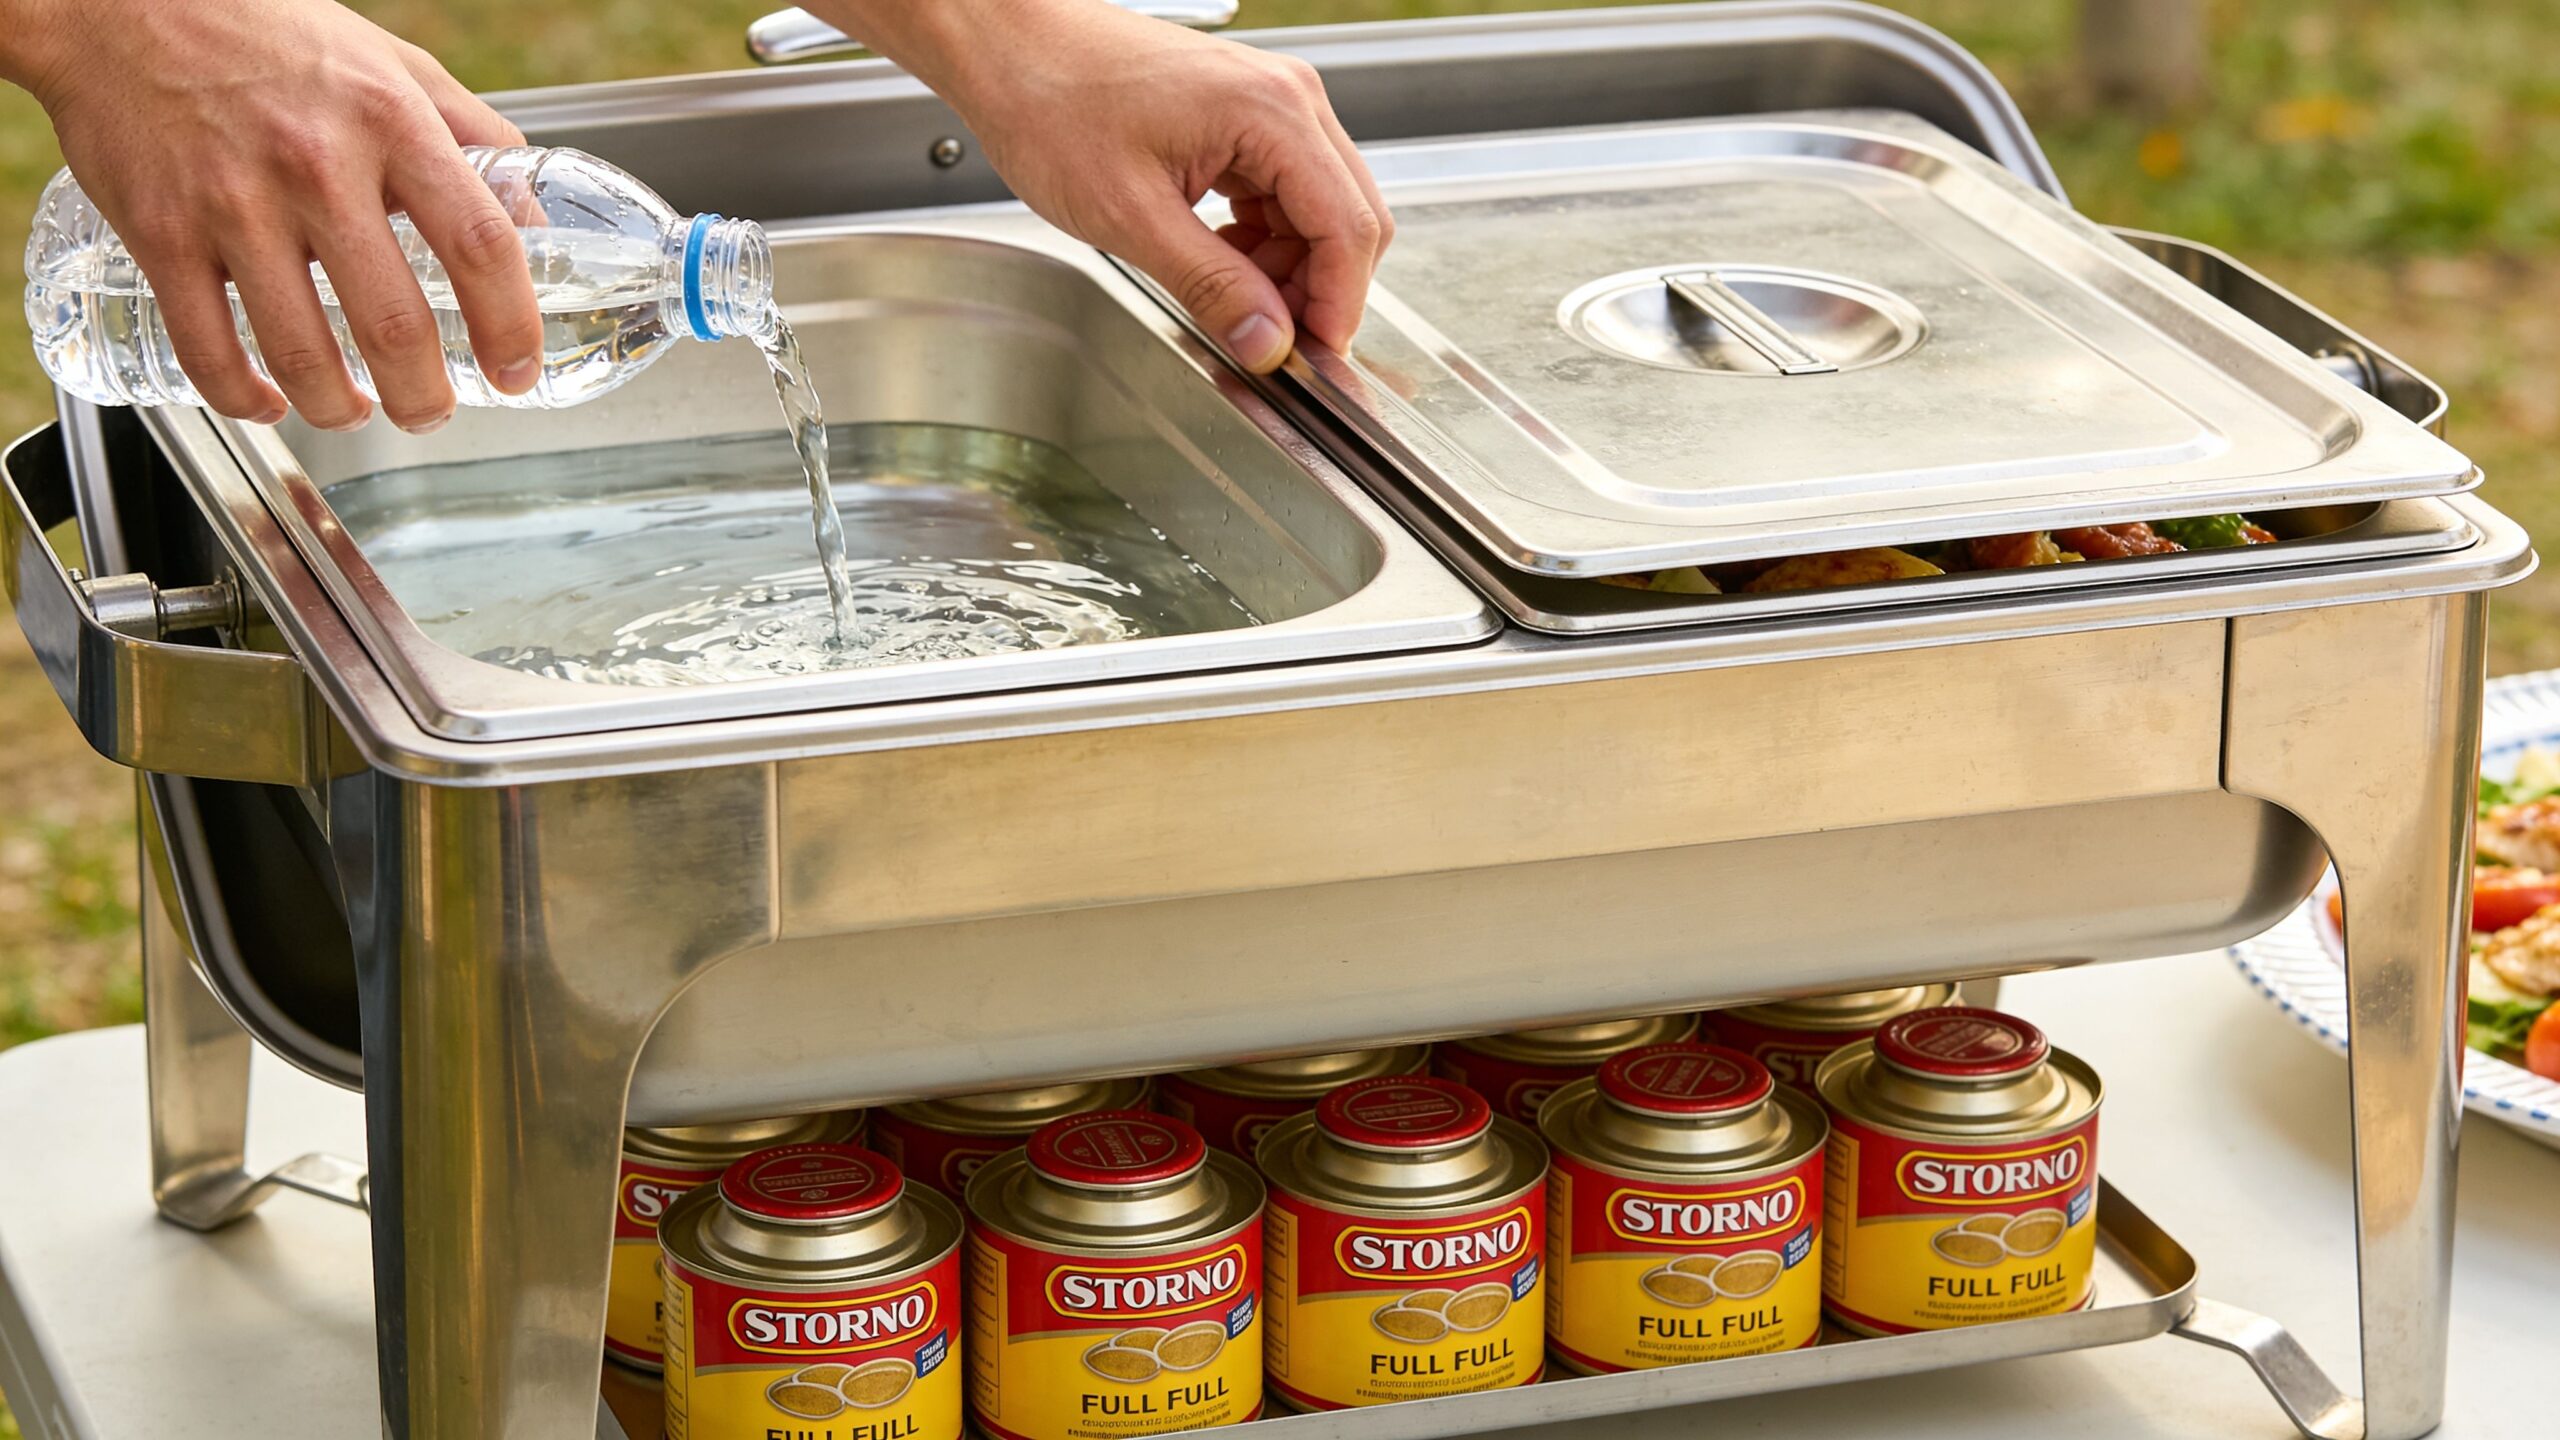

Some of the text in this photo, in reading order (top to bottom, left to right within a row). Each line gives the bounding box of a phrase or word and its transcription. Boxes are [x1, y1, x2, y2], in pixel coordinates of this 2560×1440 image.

[1914, 1148, 2078, 1195] STORNO
[1623, 1189, 1794, 1235] STORNO
[1352, 1221, 1521, 1270] STORNO
[1063, 1257, 1237, 1309] STORNO
[1928, 1264, 2066, 1298] FULL FULL
[744, 1294, 925, 1344] STORNO
[1639, 1306, 1783, 1339] FULL FULL
[1371, 1354, 1444, 1376] FULL
[1454, 1338, 1514, 1371] FULL
[1082, 1394, 1158, 1415] FULL
[1167, 1376, 1229, 1411] FULL
[852, 1414, 919, 1440] FULL
